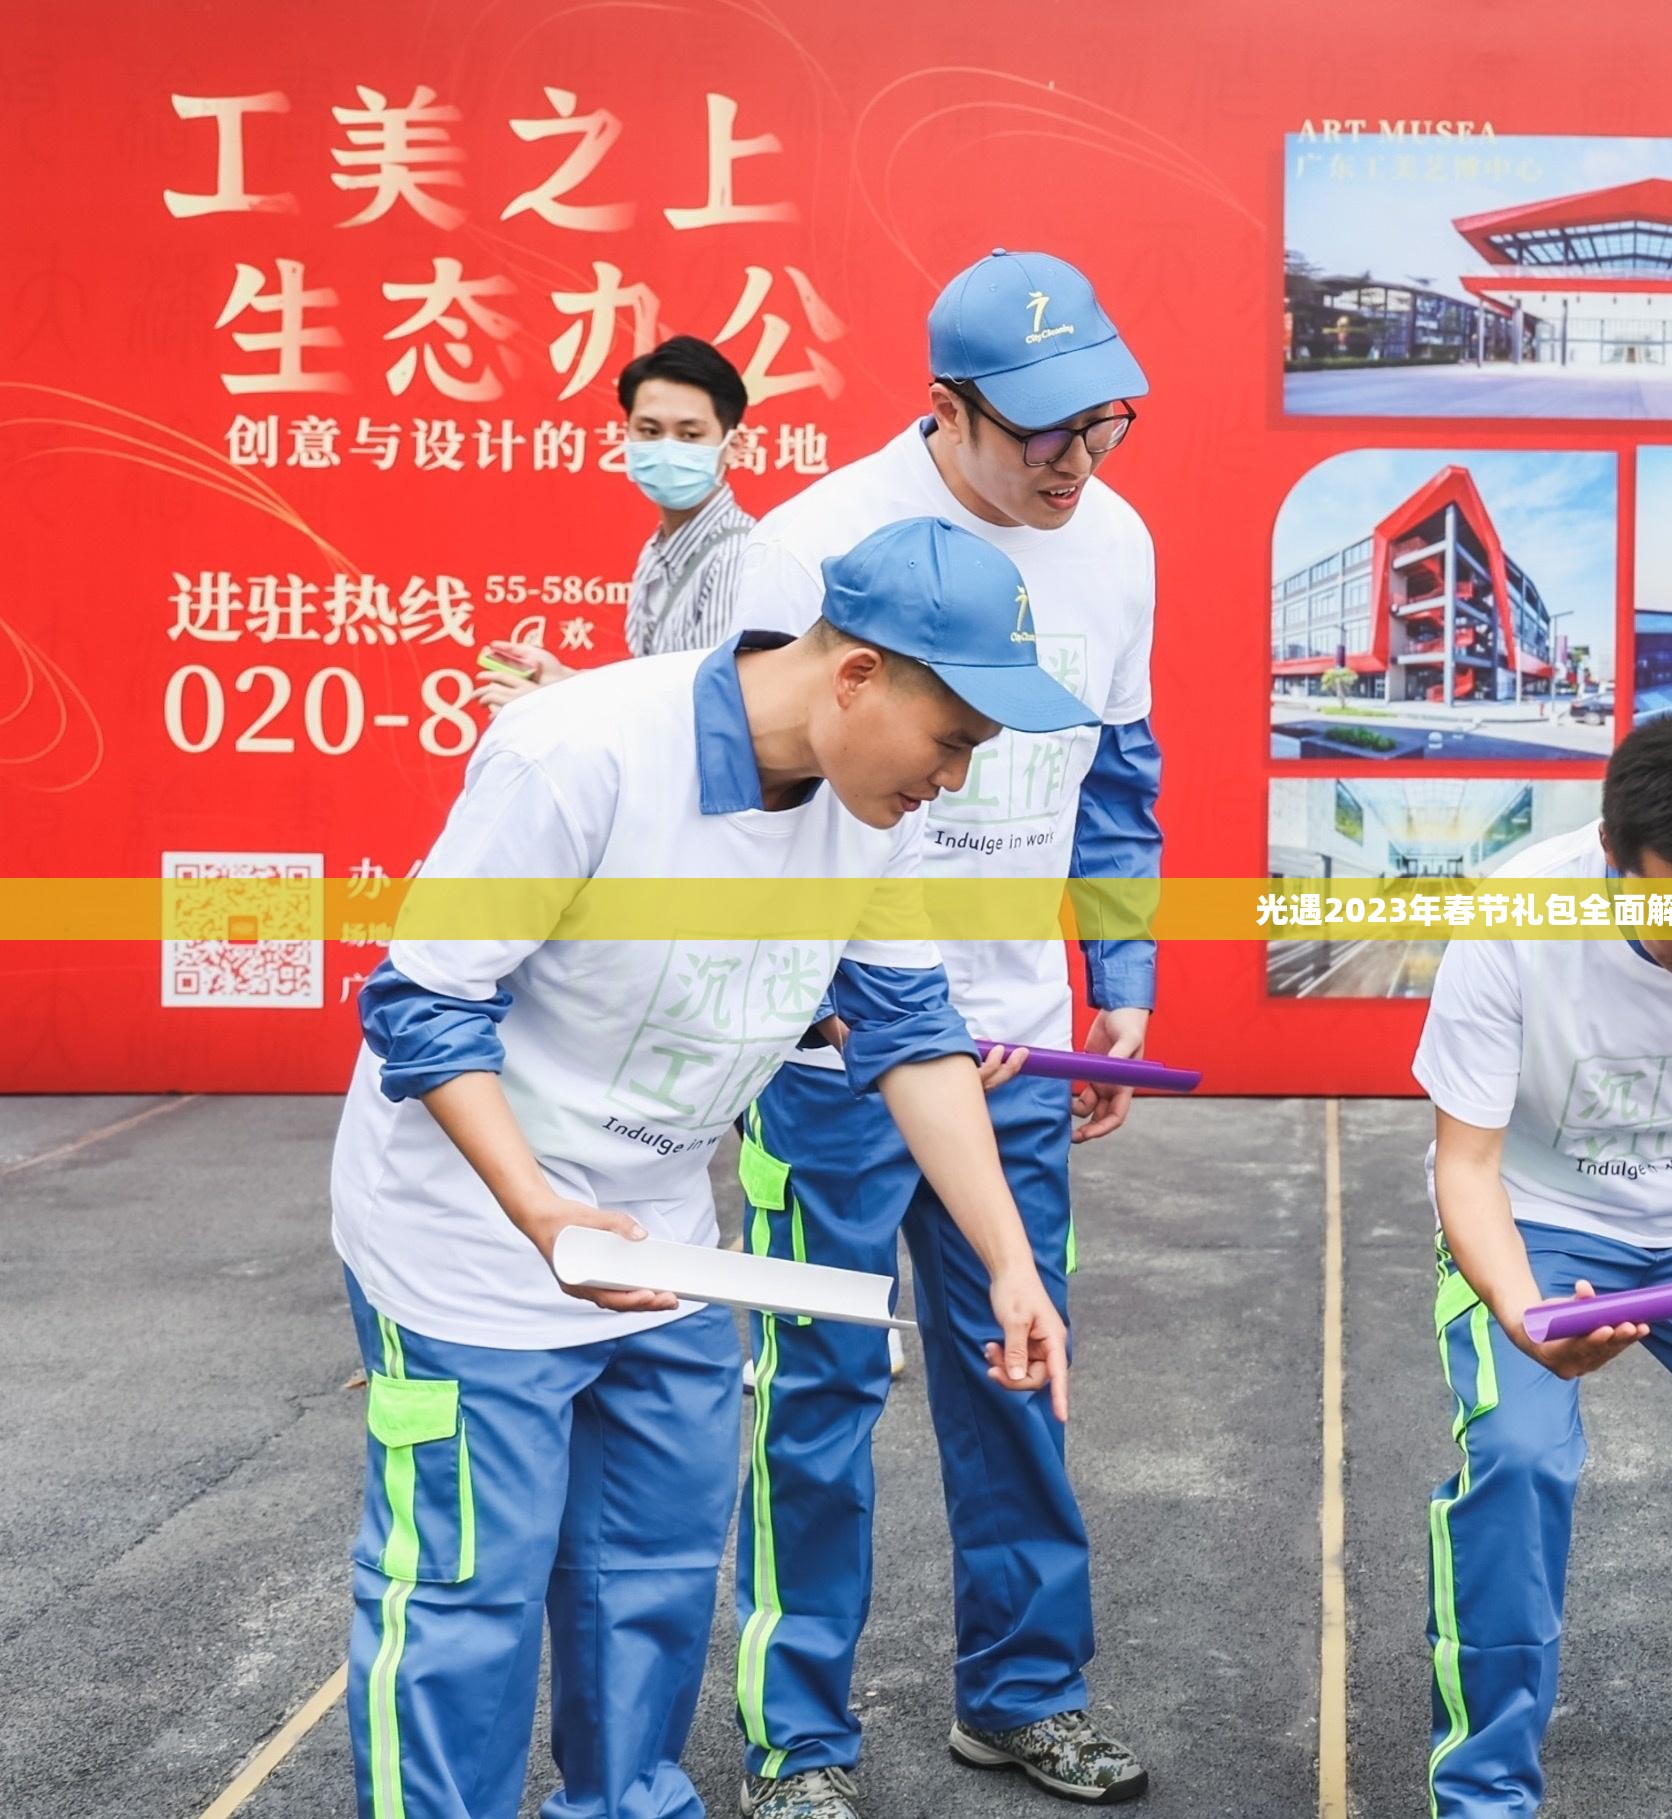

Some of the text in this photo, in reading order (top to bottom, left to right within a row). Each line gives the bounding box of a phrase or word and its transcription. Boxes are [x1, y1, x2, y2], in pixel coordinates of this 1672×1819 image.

[163, 84, 798, 232] 工美之上
[1298, 119, 1497, 145] ART MUSEA
[215, 258, 848, 406] 生态办公
[224, 414, 830, 476] 创意与设计的艺高地
[167, 571, 476, 647] 进驻热线
[934, 830, 1003, 855] Indulge
[1009, 833, 1022, 849] in
[663, 946, 823, 1030] 沉迷
[602, 1115, 684, 1156] Indulge
